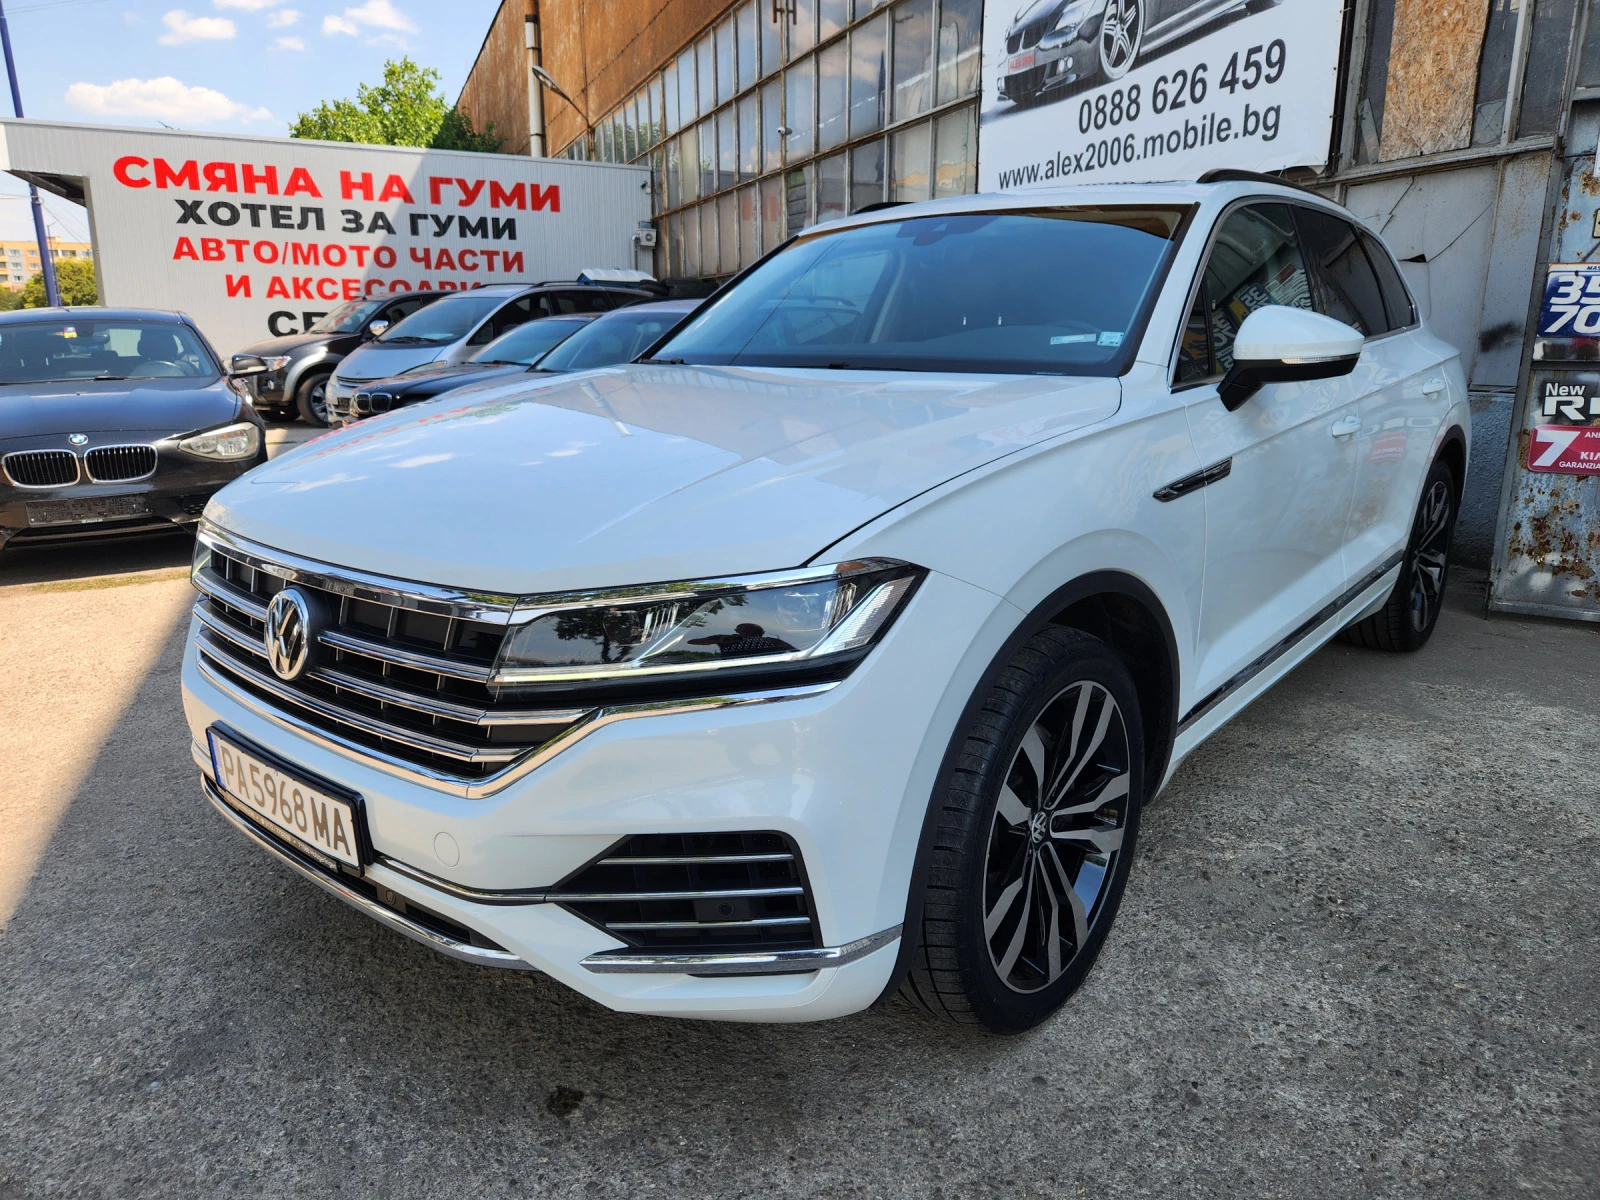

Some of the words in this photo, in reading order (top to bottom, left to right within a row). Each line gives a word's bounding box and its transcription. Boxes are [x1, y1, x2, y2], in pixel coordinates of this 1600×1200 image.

[1079, 84, 1141, 134] 0888
[1152, 63, 1208, 114] 626
[1219, 38, 1286, 95] 459
[998, 104, 1282, 190] www.alex2006.mobile.bg
[113, 156, 323, 198] СМЯНА
[339, 170, 415, 204] НА
[429, 176, 561, 212] ГУМИ
[174, 199, 326, 231] ХОТЕЛ
[340, 209, 396, 235] ЗА
[409, 213, 517, 240] ГУМИ
[172, 236, 397, 269] АВТО/МОТО
[409, 247, 524, 273] ЧАСТИ
[225, 274, 252, 298] И
[1546, 382, 1585, 396] New
[1532, 429, 1581, 467] 7
